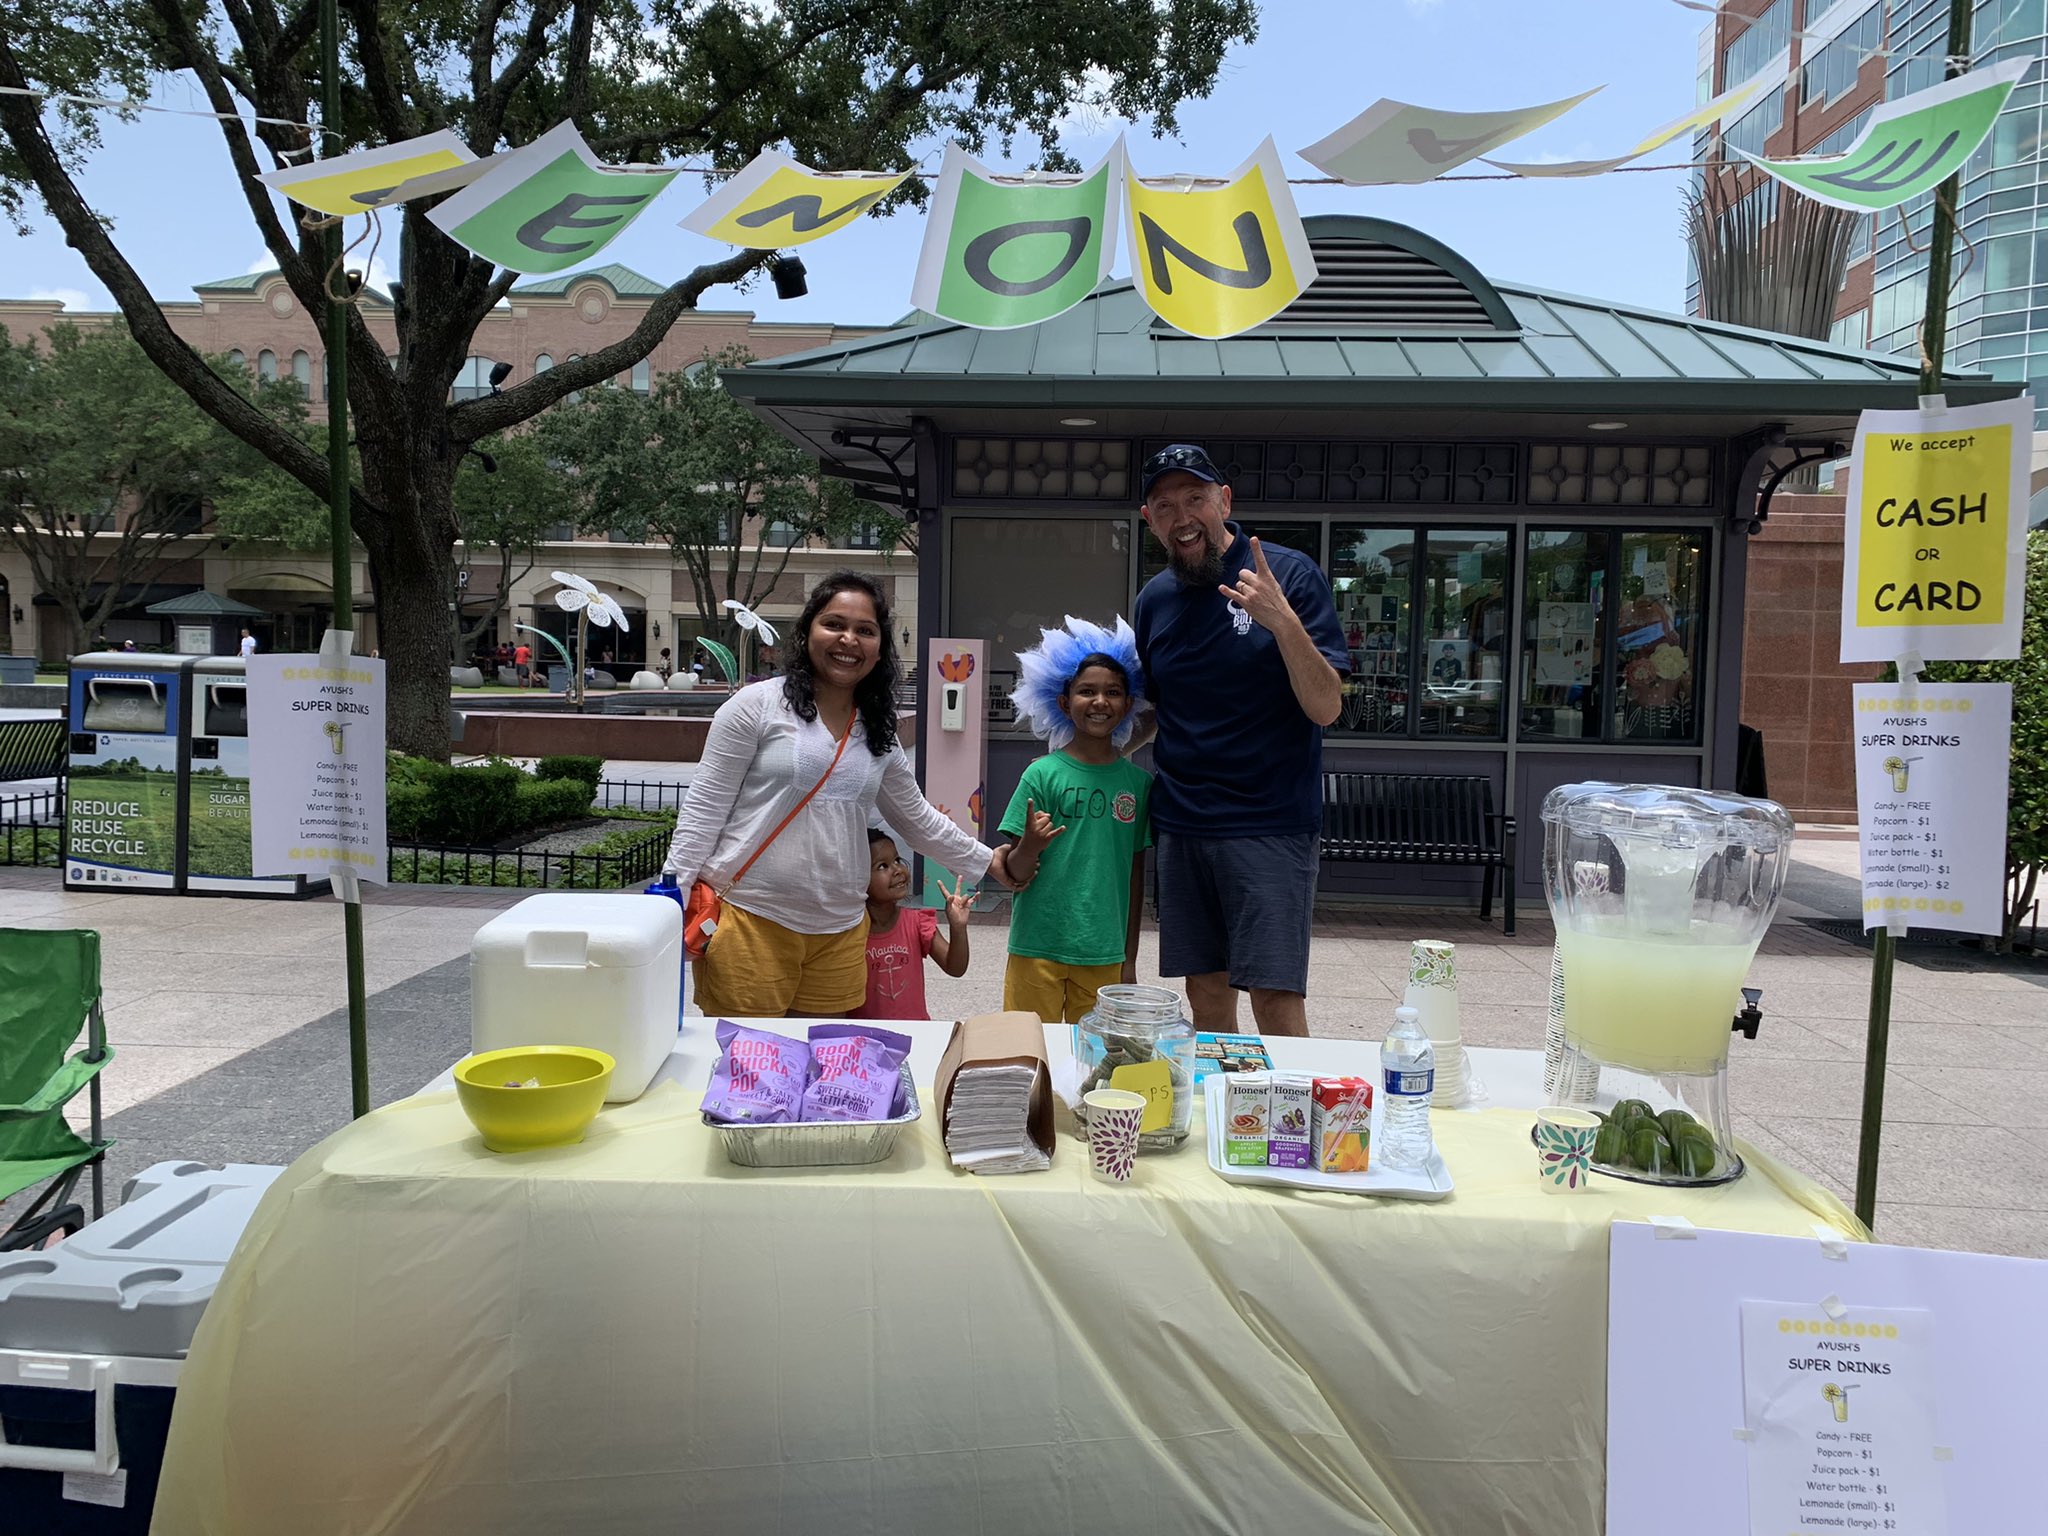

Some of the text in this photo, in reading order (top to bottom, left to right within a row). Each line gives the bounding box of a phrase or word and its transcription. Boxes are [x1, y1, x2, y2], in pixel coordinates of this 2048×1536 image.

[1889, 435, 1976, 452] We accept
[1876, 492, 1988, 528] CASH
[1915, 548, 1940, 561] OR
[1874, 580, 1982, 612] CARD
[319, 686, 354, 696] AYUSH'S
[291, 700, 370, 715] SUPER DRINKS
[1883, 717, 1928, 727] AYUSH'S
[1861, 734, 1961, 747] SUPER DRINKS
[316, 761, 338, 772] Candy
[342, 762, 359, 773] FREE
[317, 775, 345, 785] Popcorn
[209, 793, 246, 805] SUGAR
[311, 788, 334, 798] Juice
[334, 791, 350, 799] pack
[71, 799, 143, 818] REDUCE.
[306, 803, 333, 812] Water
[1058, 787, 1107, 819] CEO
[1874, 801, 1898, 811] Candy
[1907, 801, 1931, 811] FREE
[71, 819, 127, 836] REUSE.
[299, 817, 338, 827] Lemonade
[1873, 816, 1908, 827] Popcorn
[1917, 816, 1930, 826] $1
[300, 831, 338, 841] Lemonade
[1892, 832, 1914, 843] pack
[1924, 832, 1936, 842] $1
[70, 838, 148, 856] RECYCLE.
[1890, 848, 1920, 857] bottle
[1930, 848, 1943, 858] $1
[1938, 865, 1950, 874] $1
[1935, 880, 1950, 890] $2
[866, 944, 909, 960] Nautica
[730, 1040, 780, 1059] BOOM
[815, 1043, 862, 1063] BOOM
[730, 1057, 789, 1078] CHICKA
[816, 1055, 868, 1082] CHICKA
[818, 1064, 842, 1082] OP
[728, 1071, 760, 1093] POP
[817, 1084, 875, 1107] SWEET & SALTY
[1234, 1086, 1270, 1096] Honest
[1274, 1086, 1311, 1097] Honest
[847, 1100, 870, 1114] CORN
[1328, 1110, 1368, 1126] Mgo
[1817, 1341, 1861, 1352] AYUSH'S
[1788, 1358, 1892, 1375] SUPER DRINKS
[1816, 1431, 1841, 1442] Candy
[1850, 1433, 1873, 1443] FREE
[1816, 1447, 1853, 1459] Popcorn
[1861, 1449, 1873, 1459] $1
[1811, 1464, 1837, 1475] Juice
[1838, 1466, 1861, 1477] pack
[1869, 1467, 1881, 1477] $1
[1806, 1481, 1837, 1492] Water
[1838, 1483, 1867, 1493] bottle
[1876, 1484, 1888, 1494] $1
[1799, 1497, 1846, 1510] Lemonade
[1884, 1502, 1896, 1512] $1
[1800, 1515, 1846, 1527] Lemonade
[1884, 1519, 1897, 1530] $2
